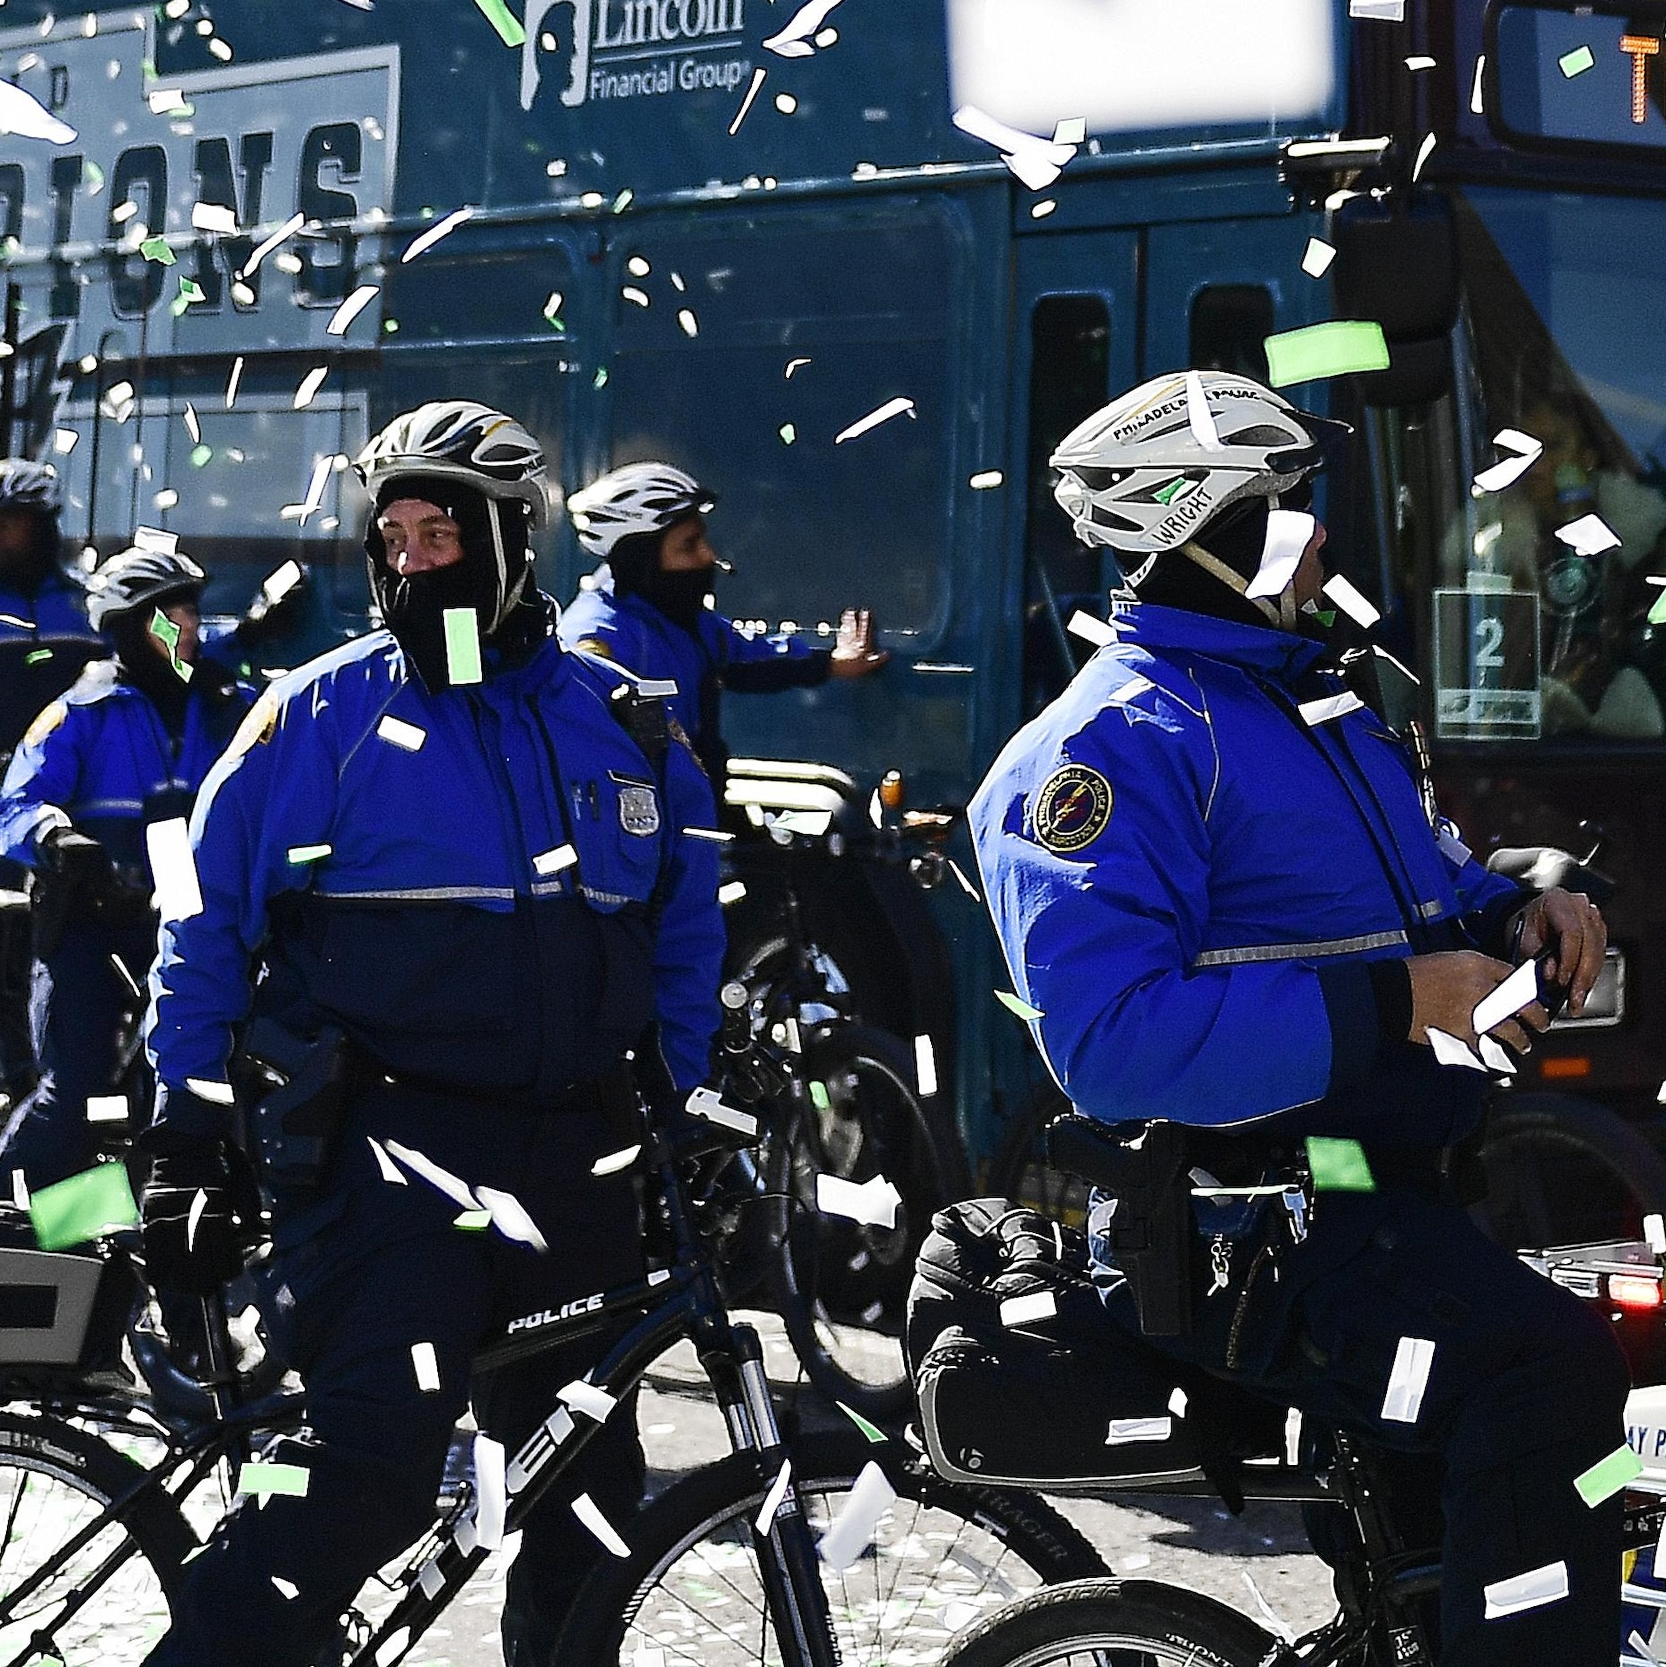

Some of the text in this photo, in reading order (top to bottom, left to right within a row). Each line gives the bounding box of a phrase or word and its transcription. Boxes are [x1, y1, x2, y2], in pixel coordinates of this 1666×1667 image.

[590, 60, 675, 101] Financial
[1151, 486, 1213, 545] WRIGHT
[1475, 617, 1506, 667] 2
[507, 1292, 605, 1335] POLICE
